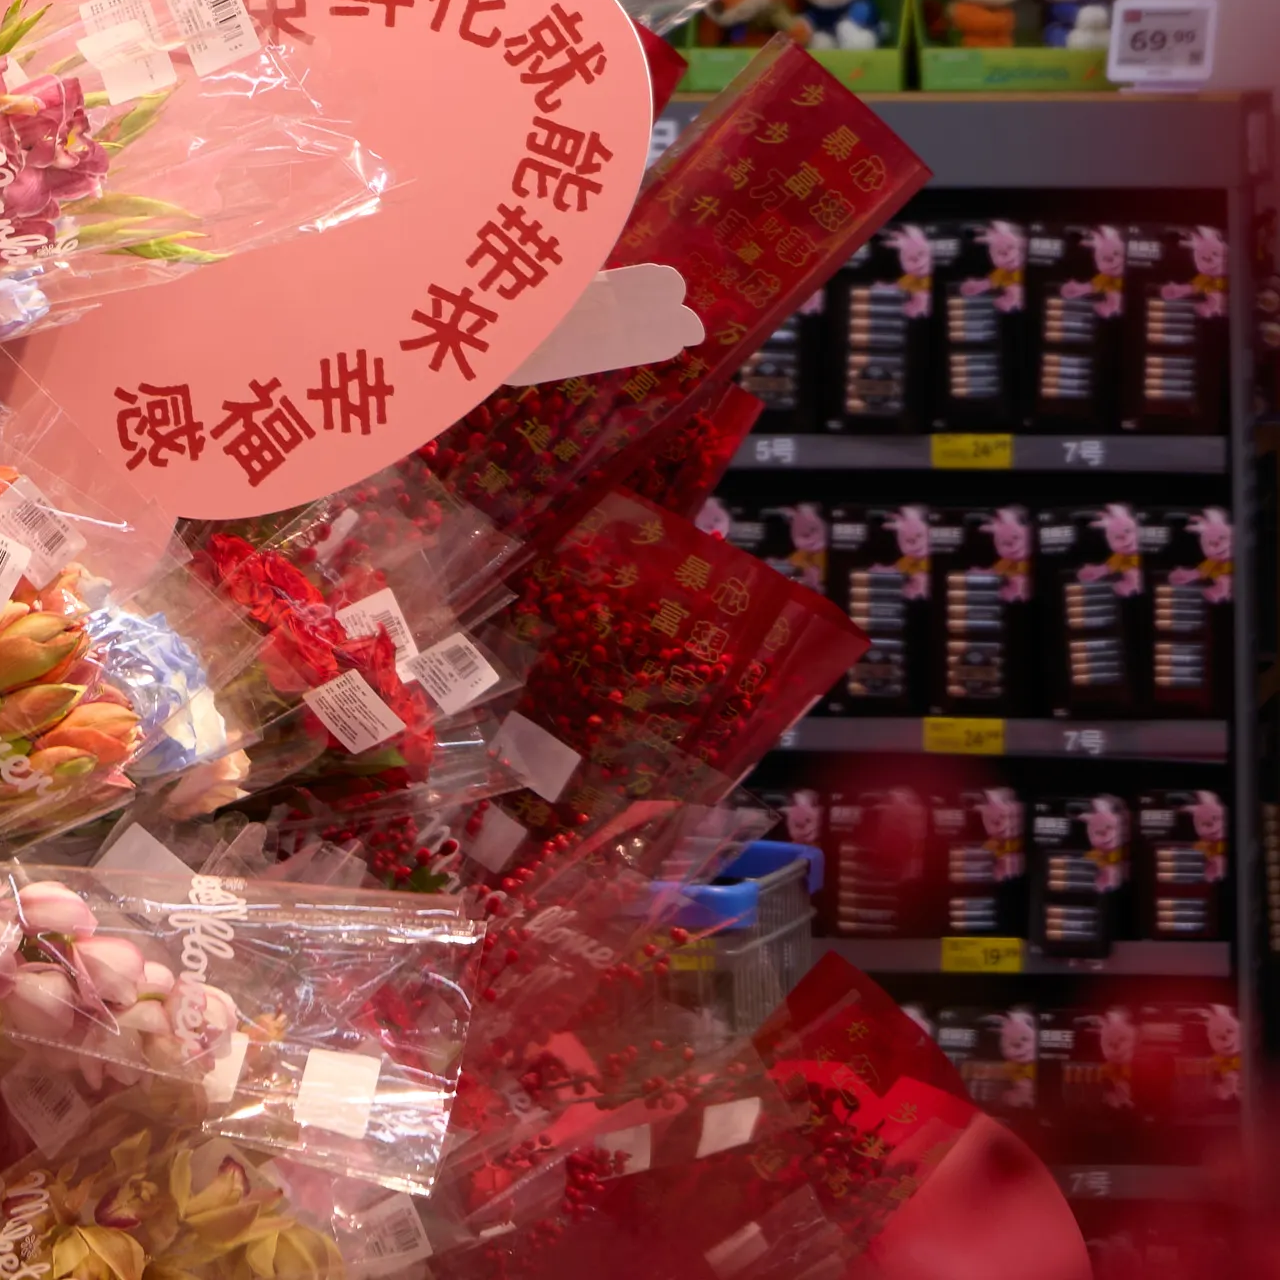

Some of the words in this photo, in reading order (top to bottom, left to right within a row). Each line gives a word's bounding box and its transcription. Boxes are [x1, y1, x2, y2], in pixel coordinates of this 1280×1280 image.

[756, 441, 794, 464] 5号
[1063, 442, 1105, 466] 7号
[1063, 728, 1104, 754] 7号
